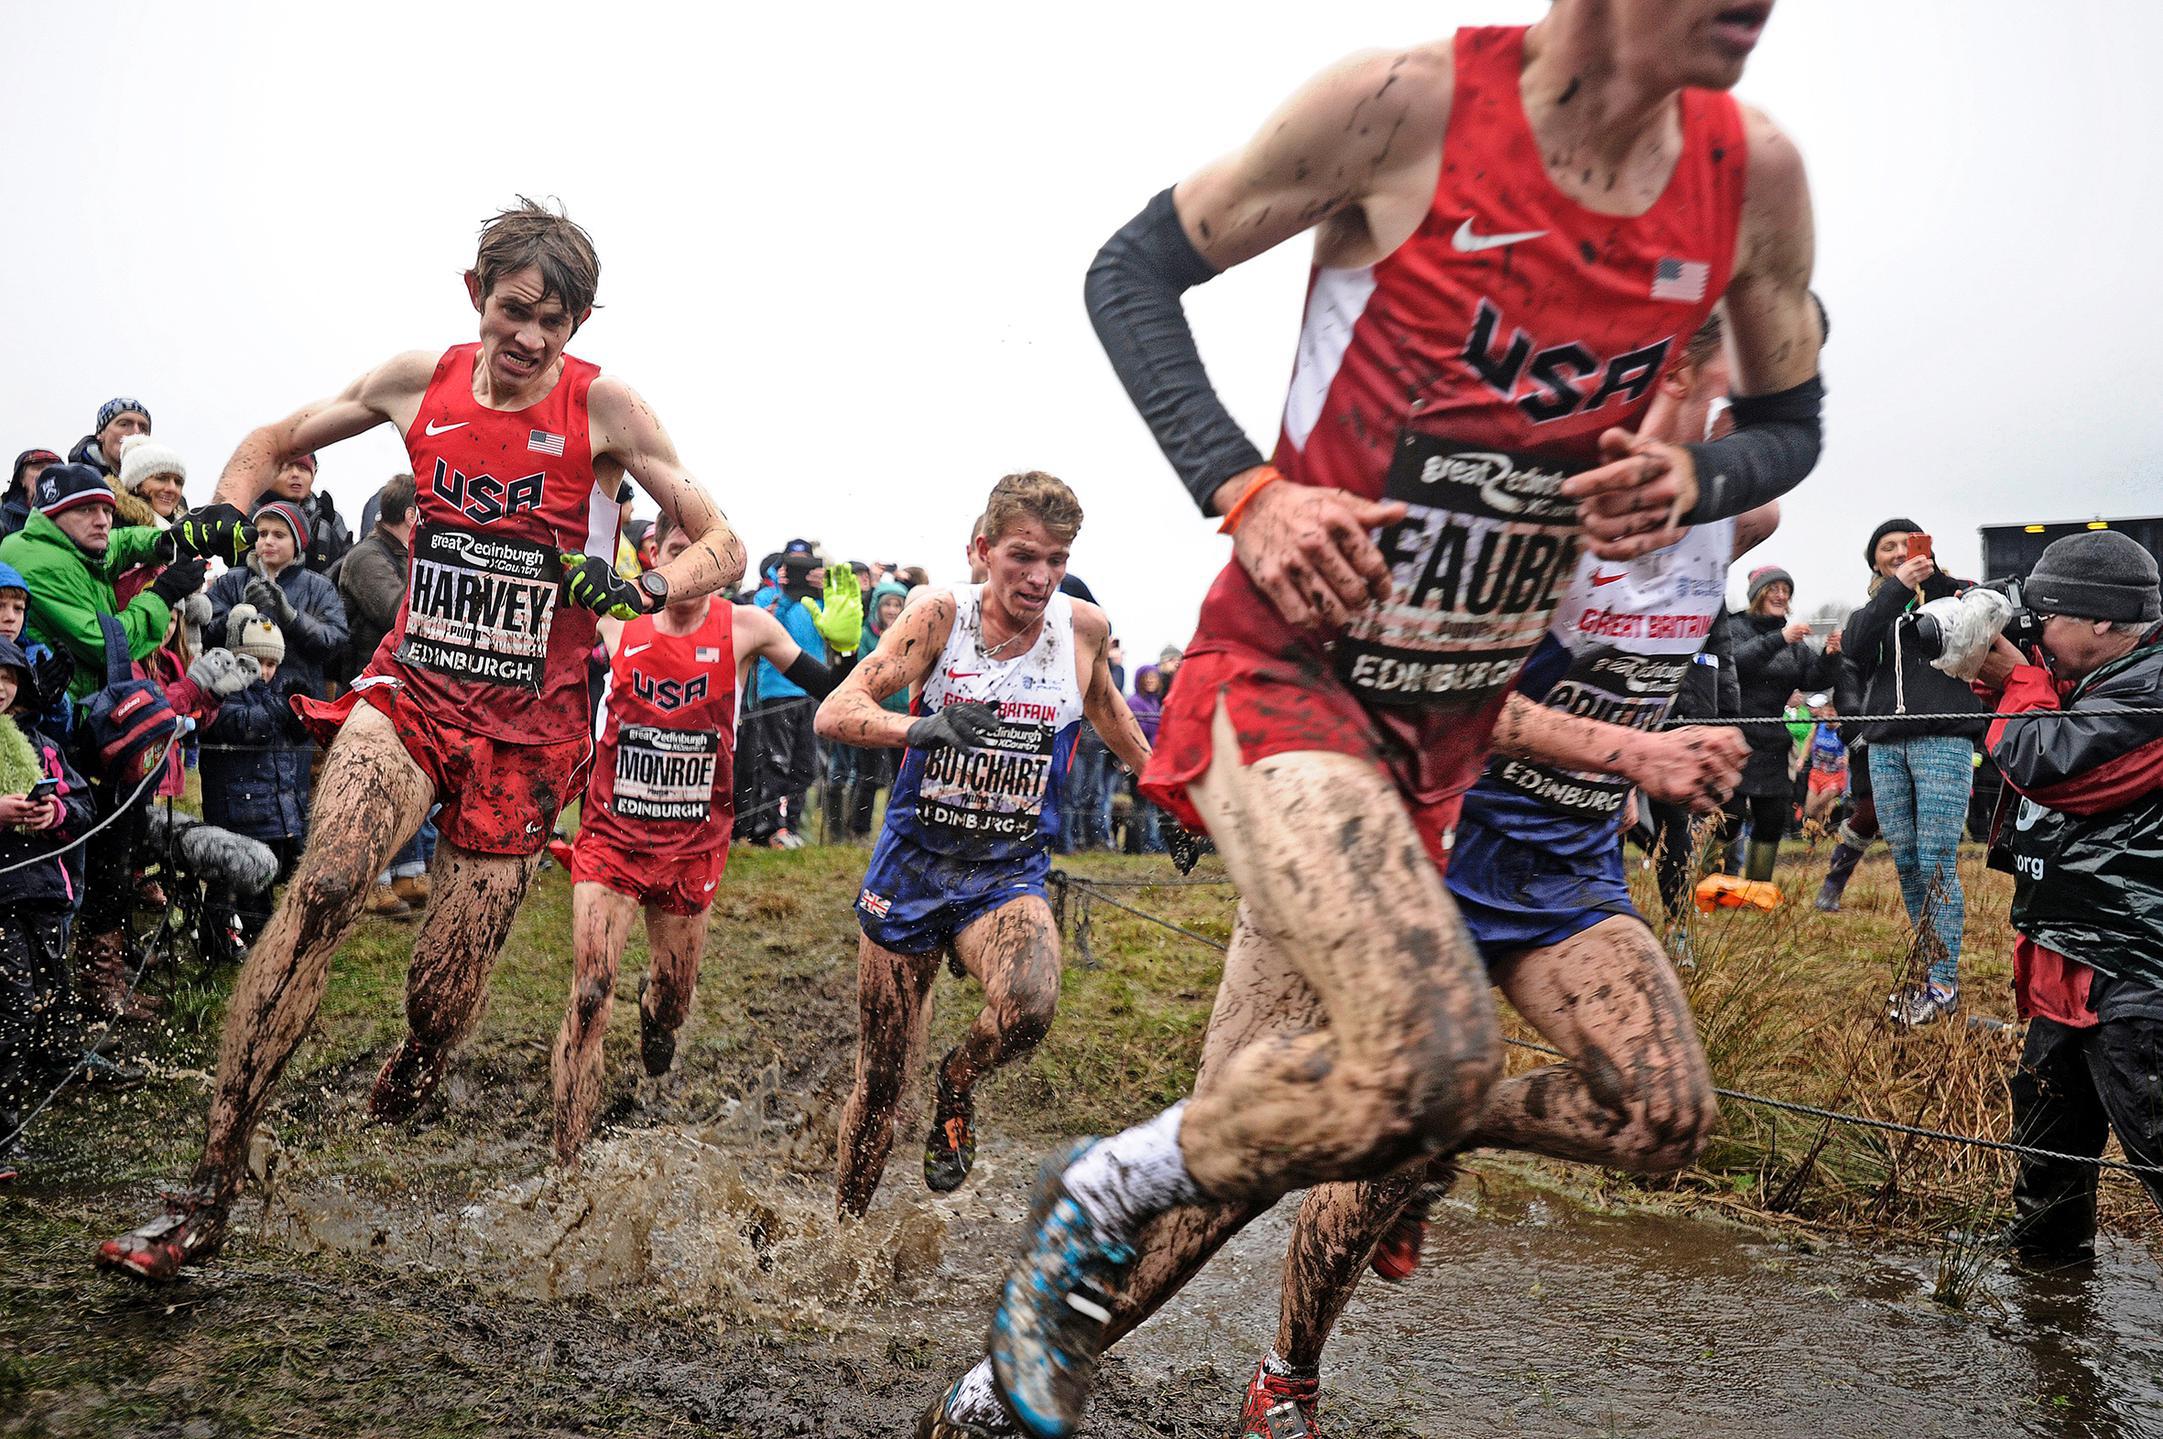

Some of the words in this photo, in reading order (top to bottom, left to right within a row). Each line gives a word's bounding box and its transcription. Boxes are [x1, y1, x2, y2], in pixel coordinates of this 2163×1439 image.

[1461, 296, 1677, 426] USA
[433, 456, 546, 525] USA
[430, 534, 462, 550] great
[474, 542, 544, 566] edinburgh
[1378, 517, 1580, 615] FAUBL
[411, 566, 553, 636] HARVEY
[407, 642, 533, 681] EDINBURGH
[632, 667, 709, 713] USA
[998, 702, 1056, 721] BRITAIN
[661, 732, 708, 746] edinburgh
[997, 739, 1040, 753] XCountry
[619, 747, 713, 786] MONROE
[925, 746, 1048, 797] BUTCHART
[617, 798, 704, 818] EDINBURGH
[2013, 853, 2044, 881] org
